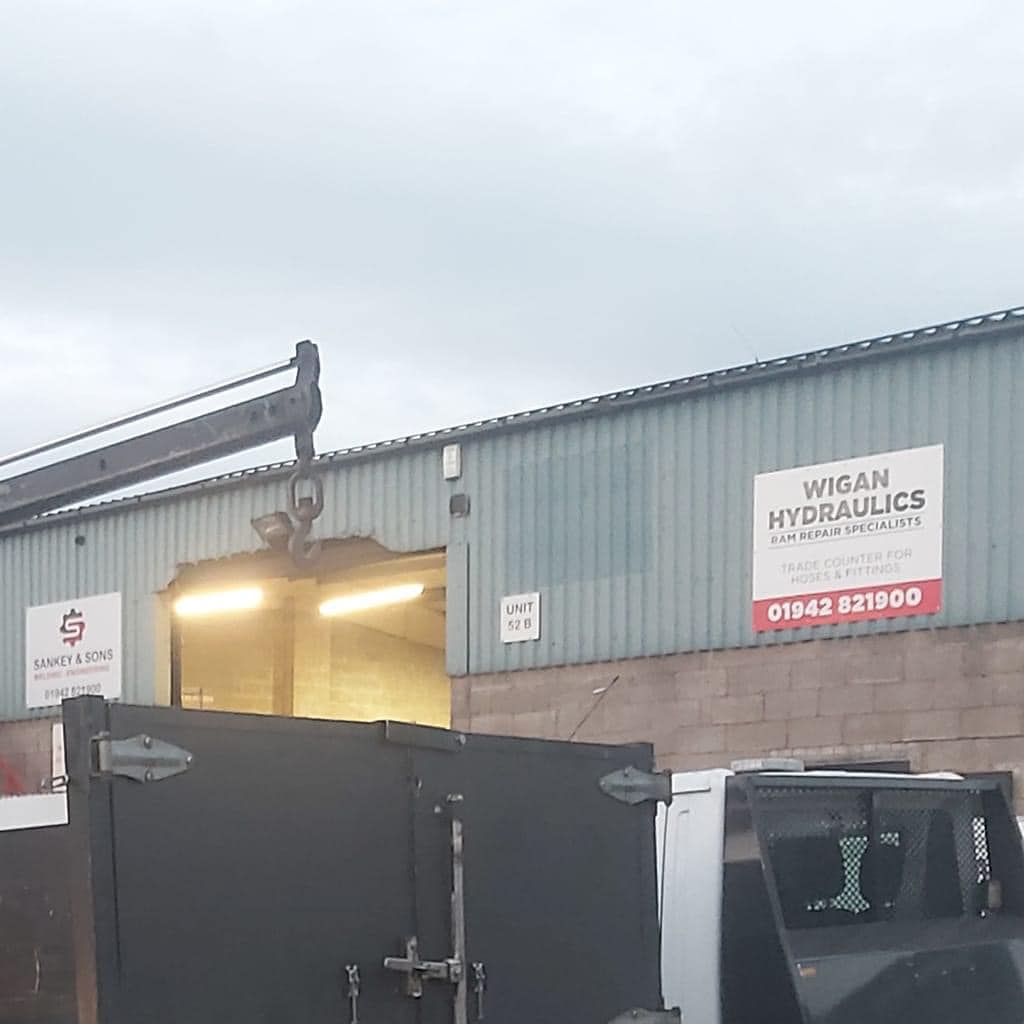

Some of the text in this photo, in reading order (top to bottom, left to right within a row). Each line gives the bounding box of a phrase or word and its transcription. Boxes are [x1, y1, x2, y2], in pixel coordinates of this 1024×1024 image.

[803, 468, 890, 500] WIGAN
[768, 489, 926, 530] HYDRAULICS
[771, 516, 922, 545] RAM REPAIR SPECIALISTS
[782, 548, 913, 573] TRADE COUNTER FOR
[846, 562, 902, 578] FITTINGS
[506, 602, 534, 615] UNIT
[767, 587, 922, 622] 01942 821900
[34, 649, 113, 670] SANKEY & SONS
